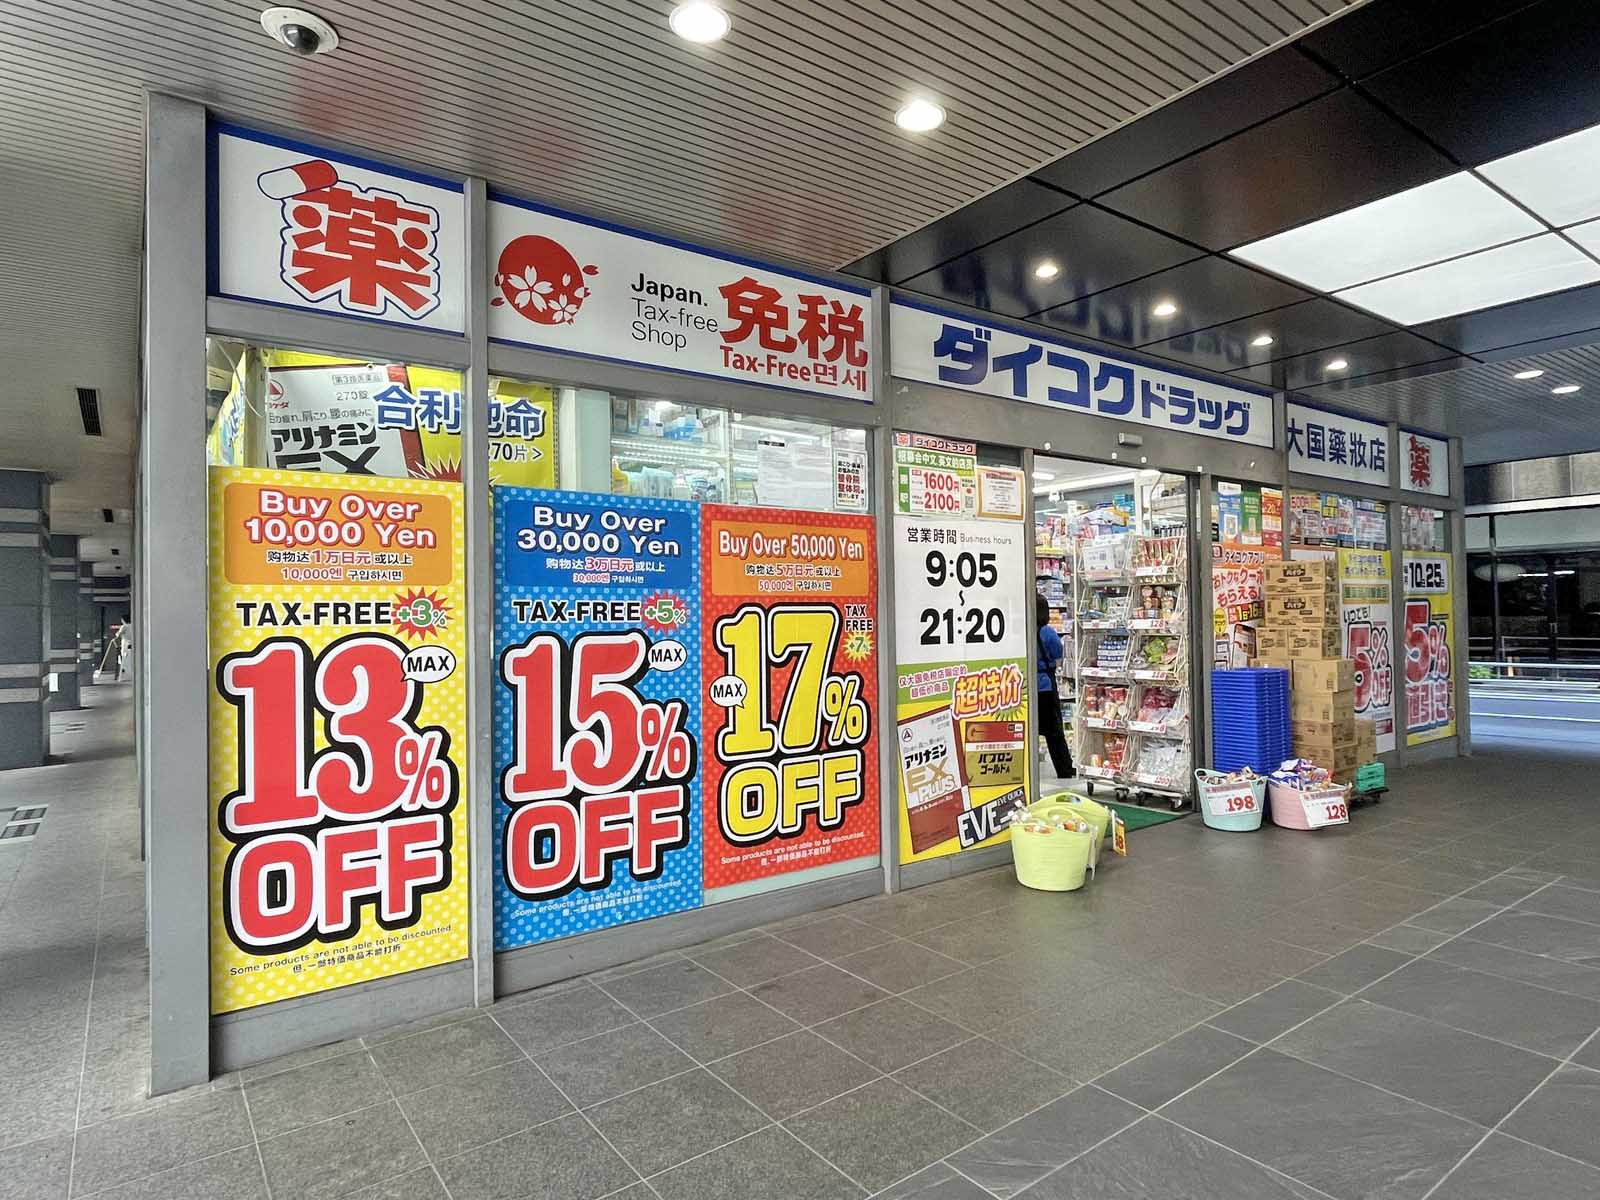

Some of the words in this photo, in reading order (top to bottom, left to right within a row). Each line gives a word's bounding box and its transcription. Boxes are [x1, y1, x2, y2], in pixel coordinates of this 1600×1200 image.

[286, 181, 435, 315] 薬
[631, 272, 709, 307] Japan.
[631, 297, 718, 333] Tax-free
[718, 276, 868, 368] 免税
[631, 320, 687, 352] Shop
[719, 345, 811, 381] Tax-Free
[812, 362, 867, 392] 면세
[933, 323, 1251, 436] ダイコクドラッグ
[270, 422, 377, 453] アリナミン
[260, 489, 328, 518] Buy
[339, 495, 420, 521] Over
[533, 505, 591, 530] Buy
[600, 510, 666, 533] Over
[245, 517, 363, 546] 10,000
[373, 522, 436, 547] Yen
[517, 529, 620, 553] 30,000
[629, 535, 680, 556] Yen
[719, 530, 749, 557] Buy
[752, 531, 787, 556] Over
[791, 533, 835, 560] 50,000
[838, 537, 863, 560] Yen
[907, 527, 957, 545] 営業時間
[959, 532, 992, 545] Business
[993, 535, 1012, 545] hours
[925, 550, 998, 588] 9:05
[236, 601, 392, 626] TAX-FREE
[398, 600, 446, 626] +3%
[513, 601, 641, 622] TAX-FREE
[645, 600, 686, 624] +5%
[845, 605, 866, 617] TAX
[845, 619, 873, 631] FREE
[920, 607, 1005, 646] 21:20
[407, 654, 450, 673] MAX
[651, 648, 683, 663] MAX
[713, 684, 743, 698] MAX
[720, 610, 866, 755] 17%
[954, 665, 1023, 717] 超特价
[510, 640, 690, 796] 15%
[228, 640, 449, 831] 13%
[904, 743, 947, 770] アリナミン
[906, 756, 949, 794] EX
[724, 753, 861, 838] OFF
[1226, 795, 1255, 812] 198
[1325, 803, 1347, 820] 128
[509, 787, 682, 890] OFF
[957, 800, 1003, 847] EVE
[237, 819, 440, 940] OFF
[229, 963, 260, 976] Some
[263, 953, 310, 970] products
[313, 949, 330, 958] are
[333, 945, 349, 954] not
[352, 940, 372, 951] able
[376, 937, 385, 946] to
[387, 935, 400, 944] be
[401, 924, 452, 941] discounted
